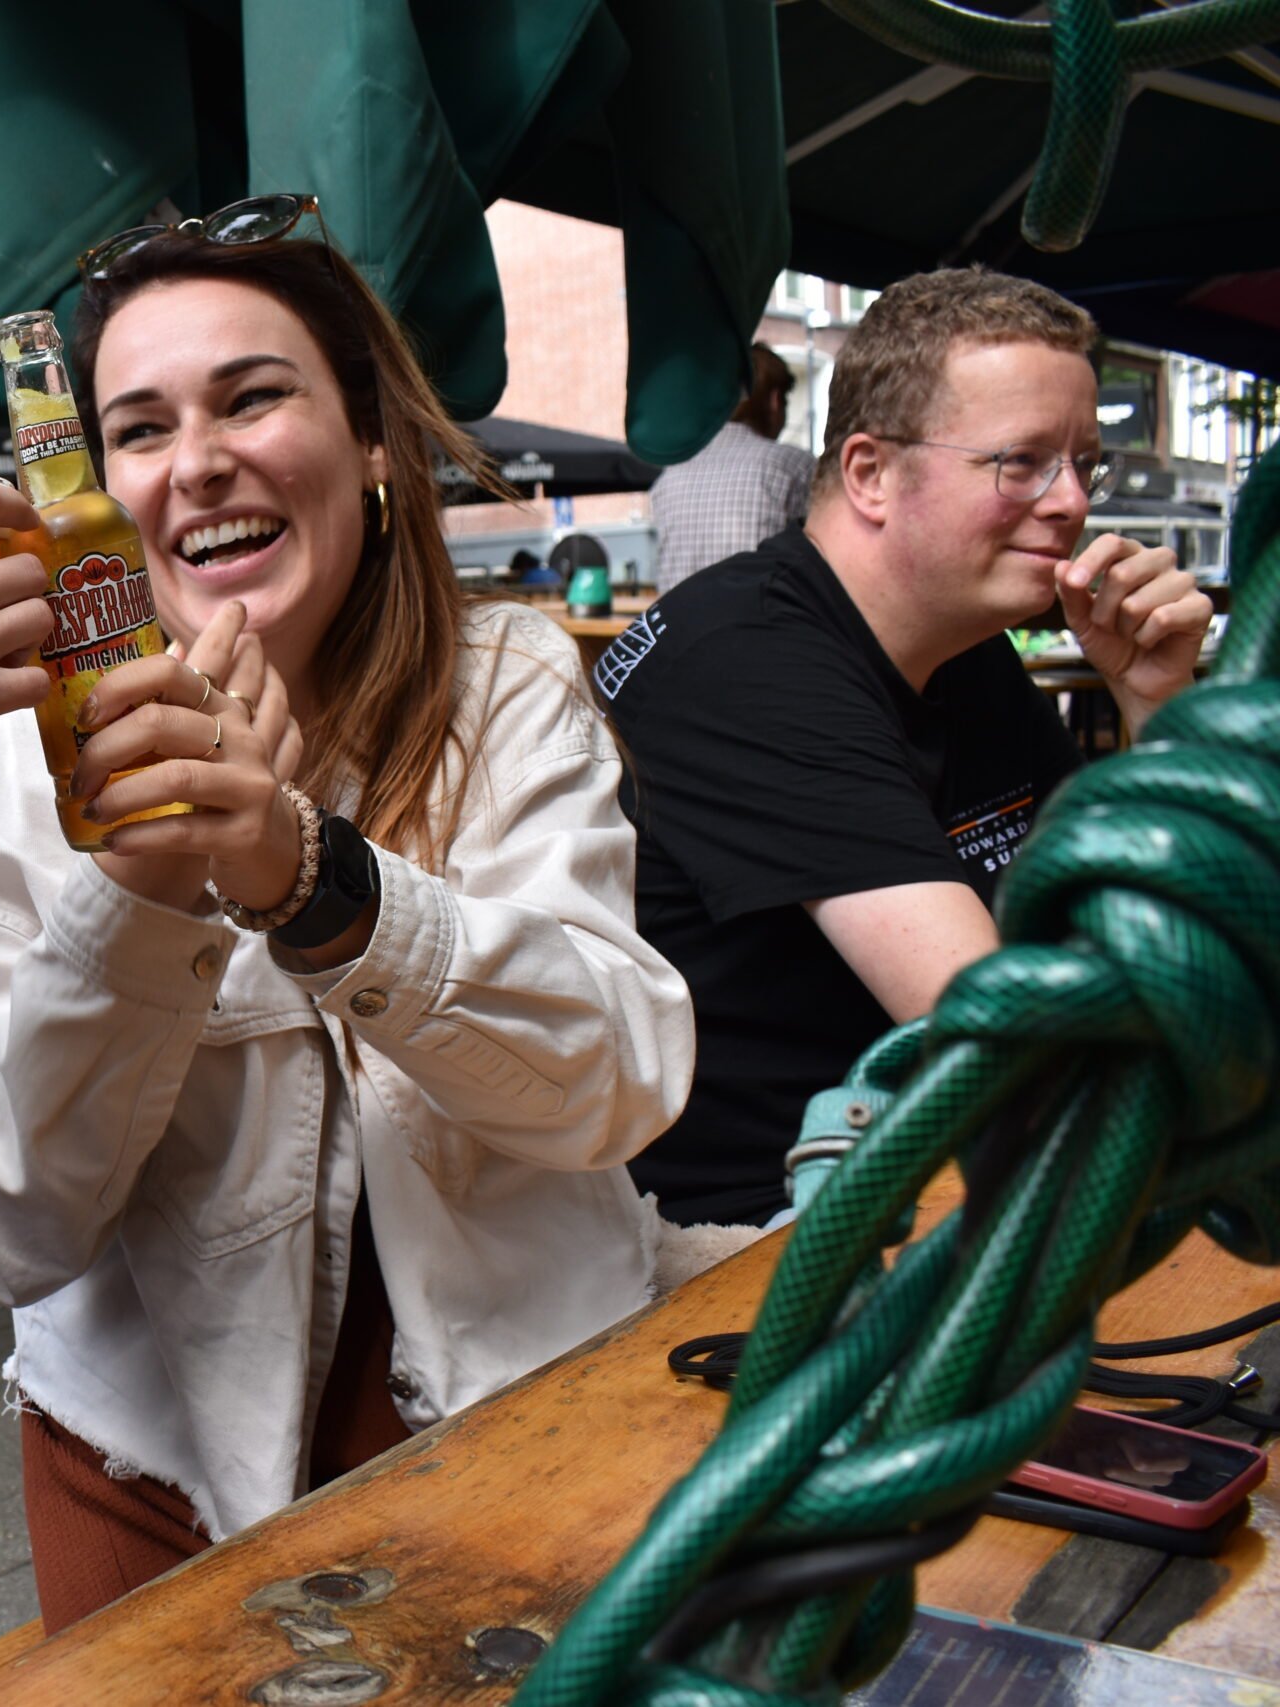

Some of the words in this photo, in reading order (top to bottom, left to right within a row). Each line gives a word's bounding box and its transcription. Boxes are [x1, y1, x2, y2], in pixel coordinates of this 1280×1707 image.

[22, 443, 45, 458] DON'T
[47, 440, 58, 450] BE
[40, 450, 54, 458] THIS
[75, 641, 143, 673] ORIGINAL
[957, 821, 1031, 860] TOWARD
